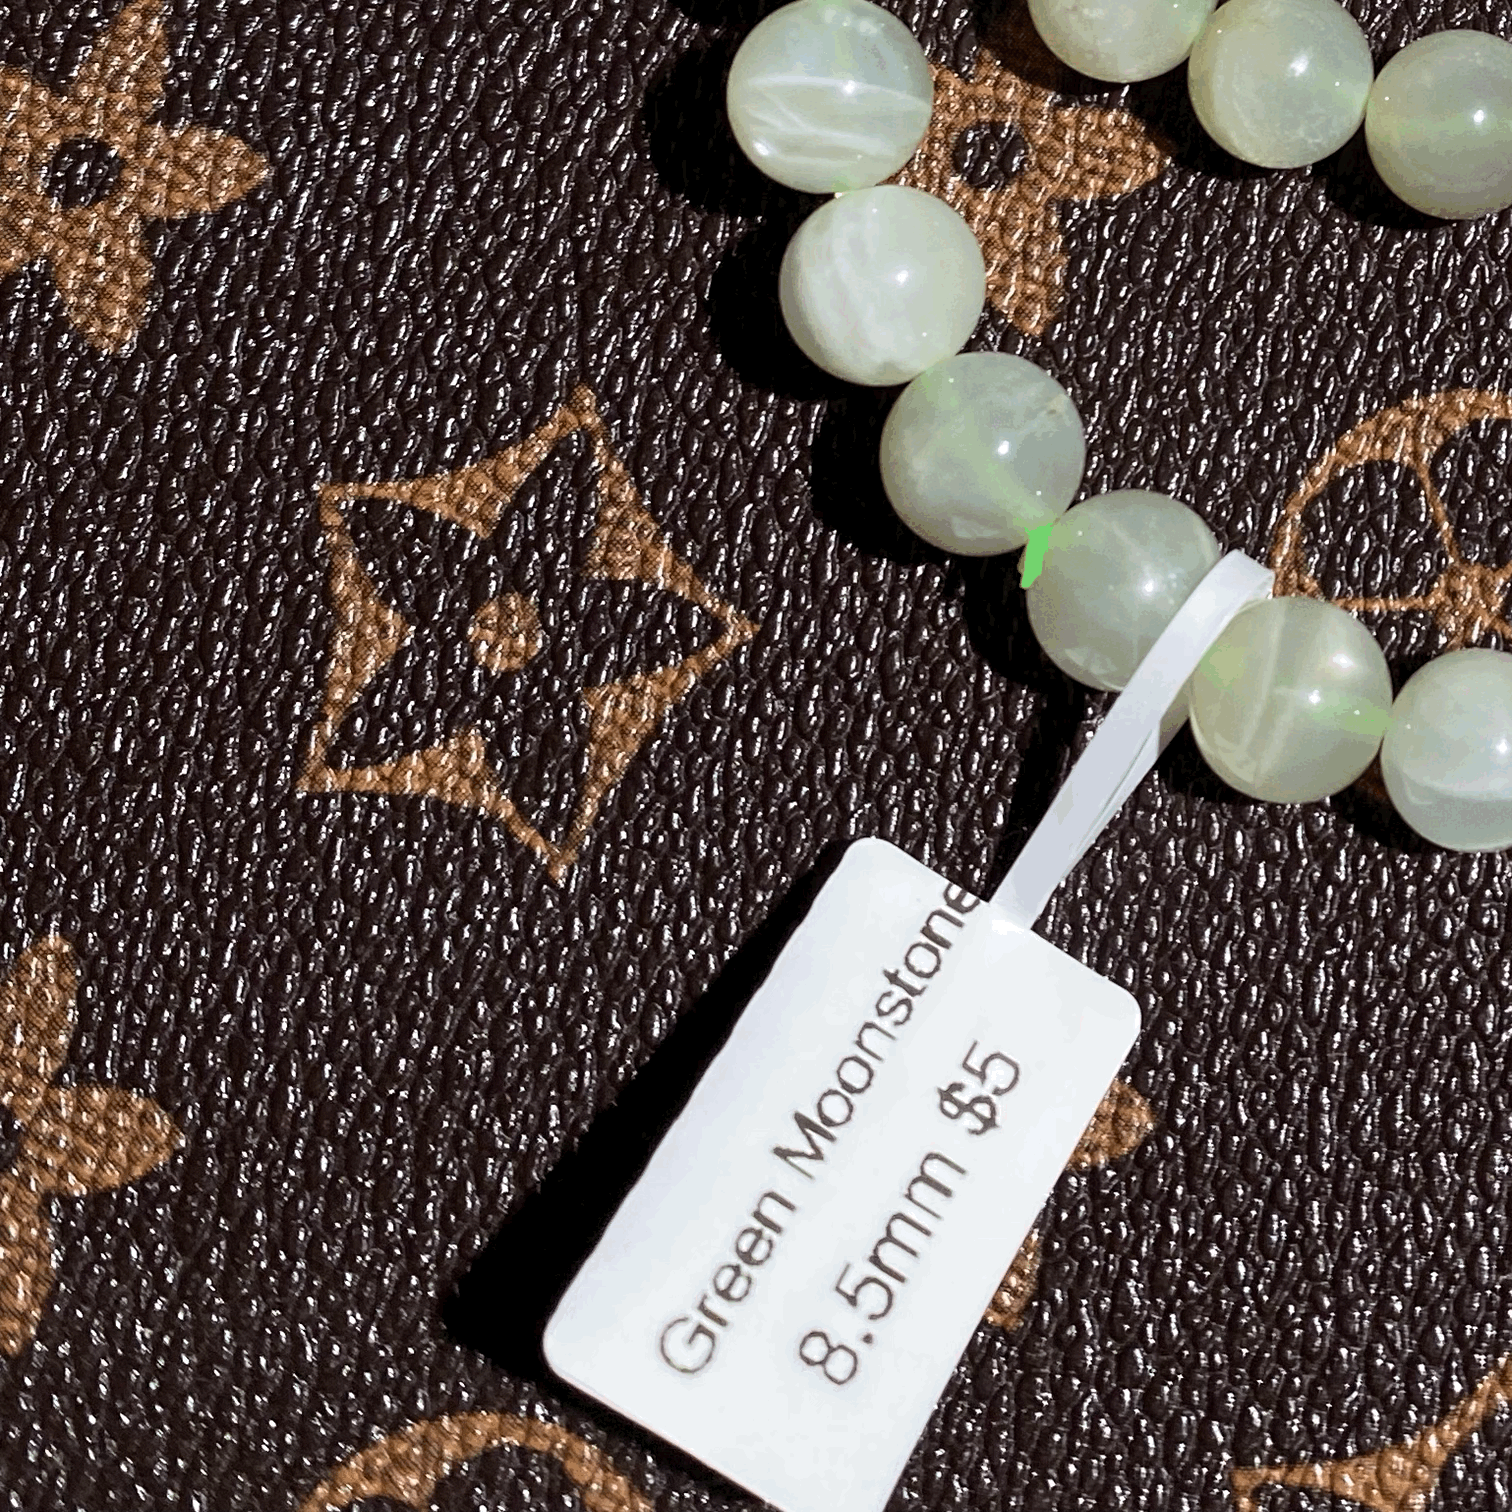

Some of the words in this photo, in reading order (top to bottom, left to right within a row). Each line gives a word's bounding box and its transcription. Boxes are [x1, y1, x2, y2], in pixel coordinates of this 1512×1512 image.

[659, 1191, 797, 1374] Green
[772, 882, 981, 1179] Moonstone
[797, 1149, 968, 1387] 8.5mm
[936, 1039, 1021, 1137] $5
